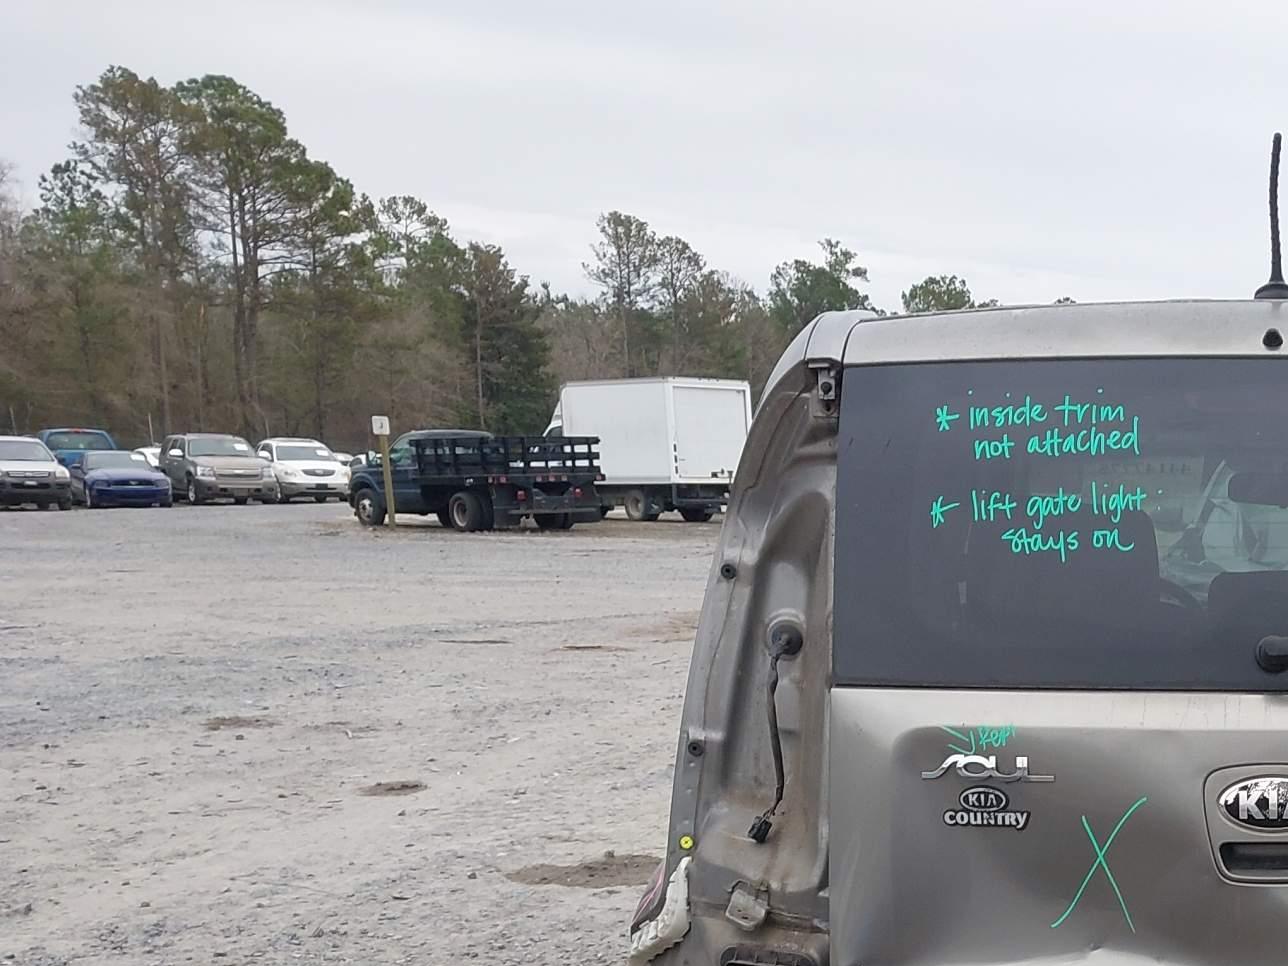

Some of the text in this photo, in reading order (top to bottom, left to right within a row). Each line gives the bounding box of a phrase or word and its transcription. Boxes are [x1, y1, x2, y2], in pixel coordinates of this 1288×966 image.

[968, 388, 1126, 430] inside trim
[974, 415, 1141, 460] not attached
[971, 481, 1148, 529] lift gate light
[1001, 527, 1135, 563] stays on
[967, 793, 997, 807] KIA
